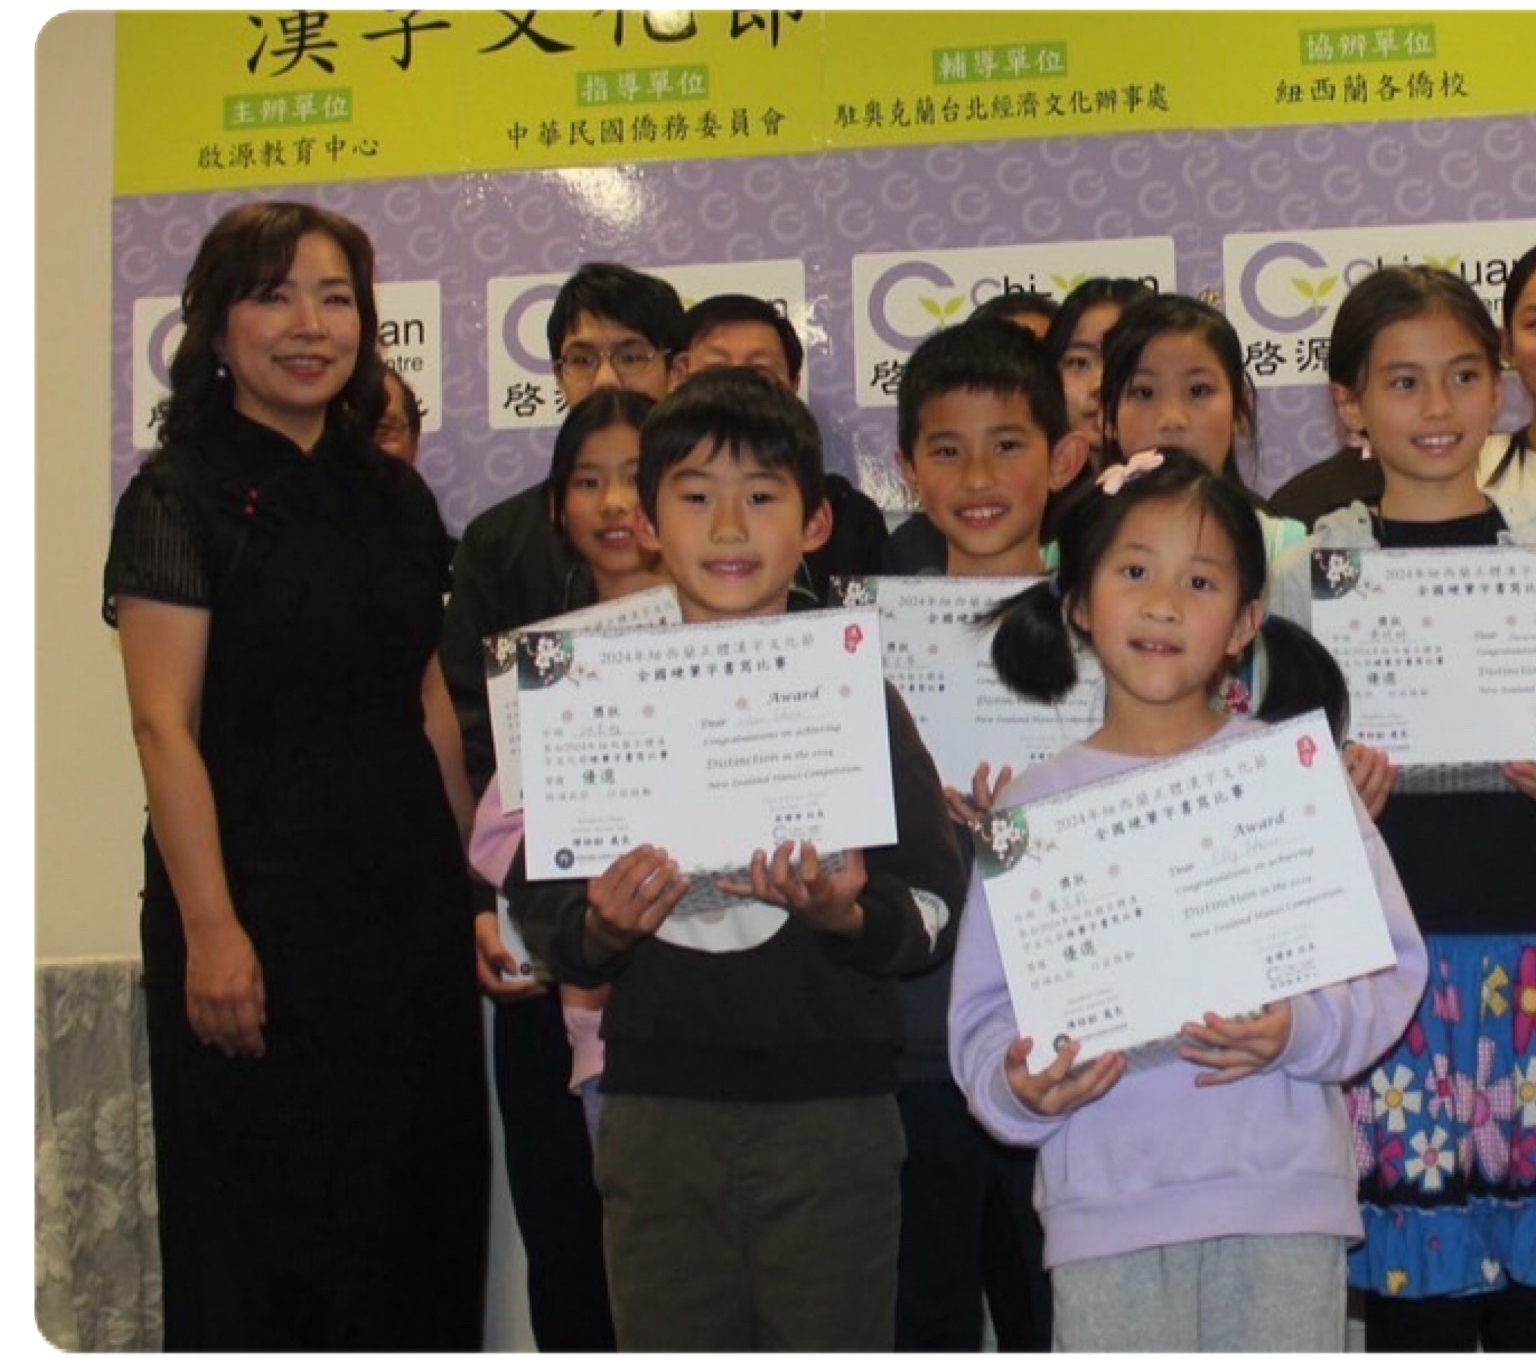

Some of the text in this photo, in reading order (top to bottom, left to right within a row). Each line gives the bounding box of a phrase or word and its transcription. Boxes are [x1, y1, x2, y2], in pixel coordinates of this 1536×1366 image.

[939, 46, 1065, 82] 輔導單位
[581, 68, 706, 103] 指導單位
[1274, 69, 1470, 105] 紐西蘭各僑校
[506, 107, 787, 151] 中華民國僑務委員會
[767, 685, 822, 705] Award
[1232, 807, 1286, 839] Award
